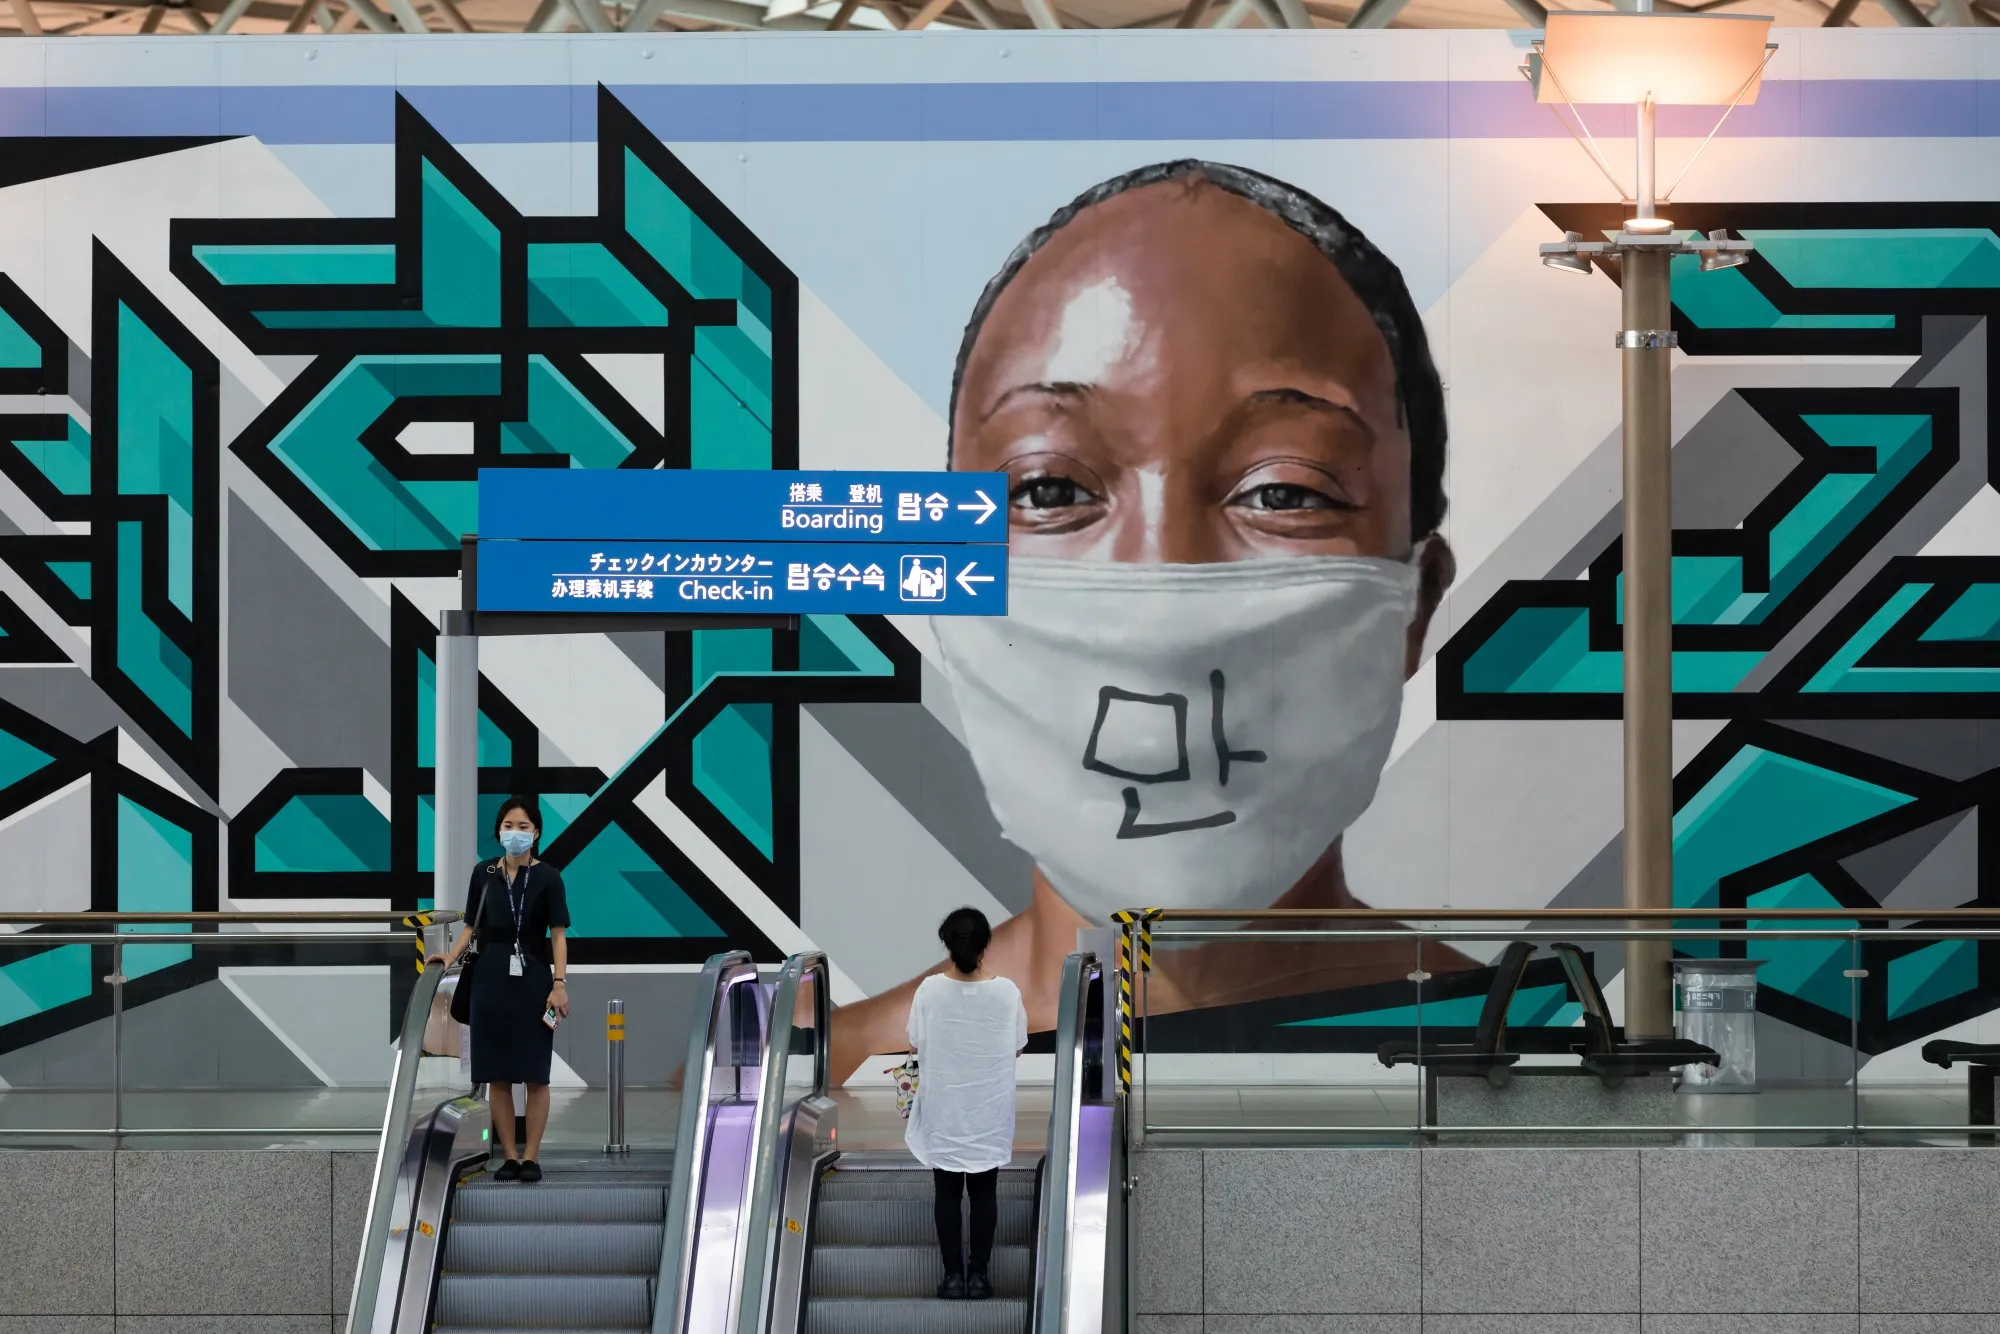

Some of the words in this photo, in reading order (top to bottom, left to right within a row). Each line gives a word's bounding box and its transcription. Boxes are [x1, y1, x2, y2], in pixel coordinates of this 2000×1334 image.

[848, 483, 884, 504] 登机
[897, 491, 949, 522] 탑승
[781, 508, 884, 534] Boarding
[589, 552, 774, 573] チェックインカウンター
[787, 562, 885, 592] 탑승수속
[551, 578, 654, 600] 办理乘机手续
[678, 579, 773, 601] Check-in
